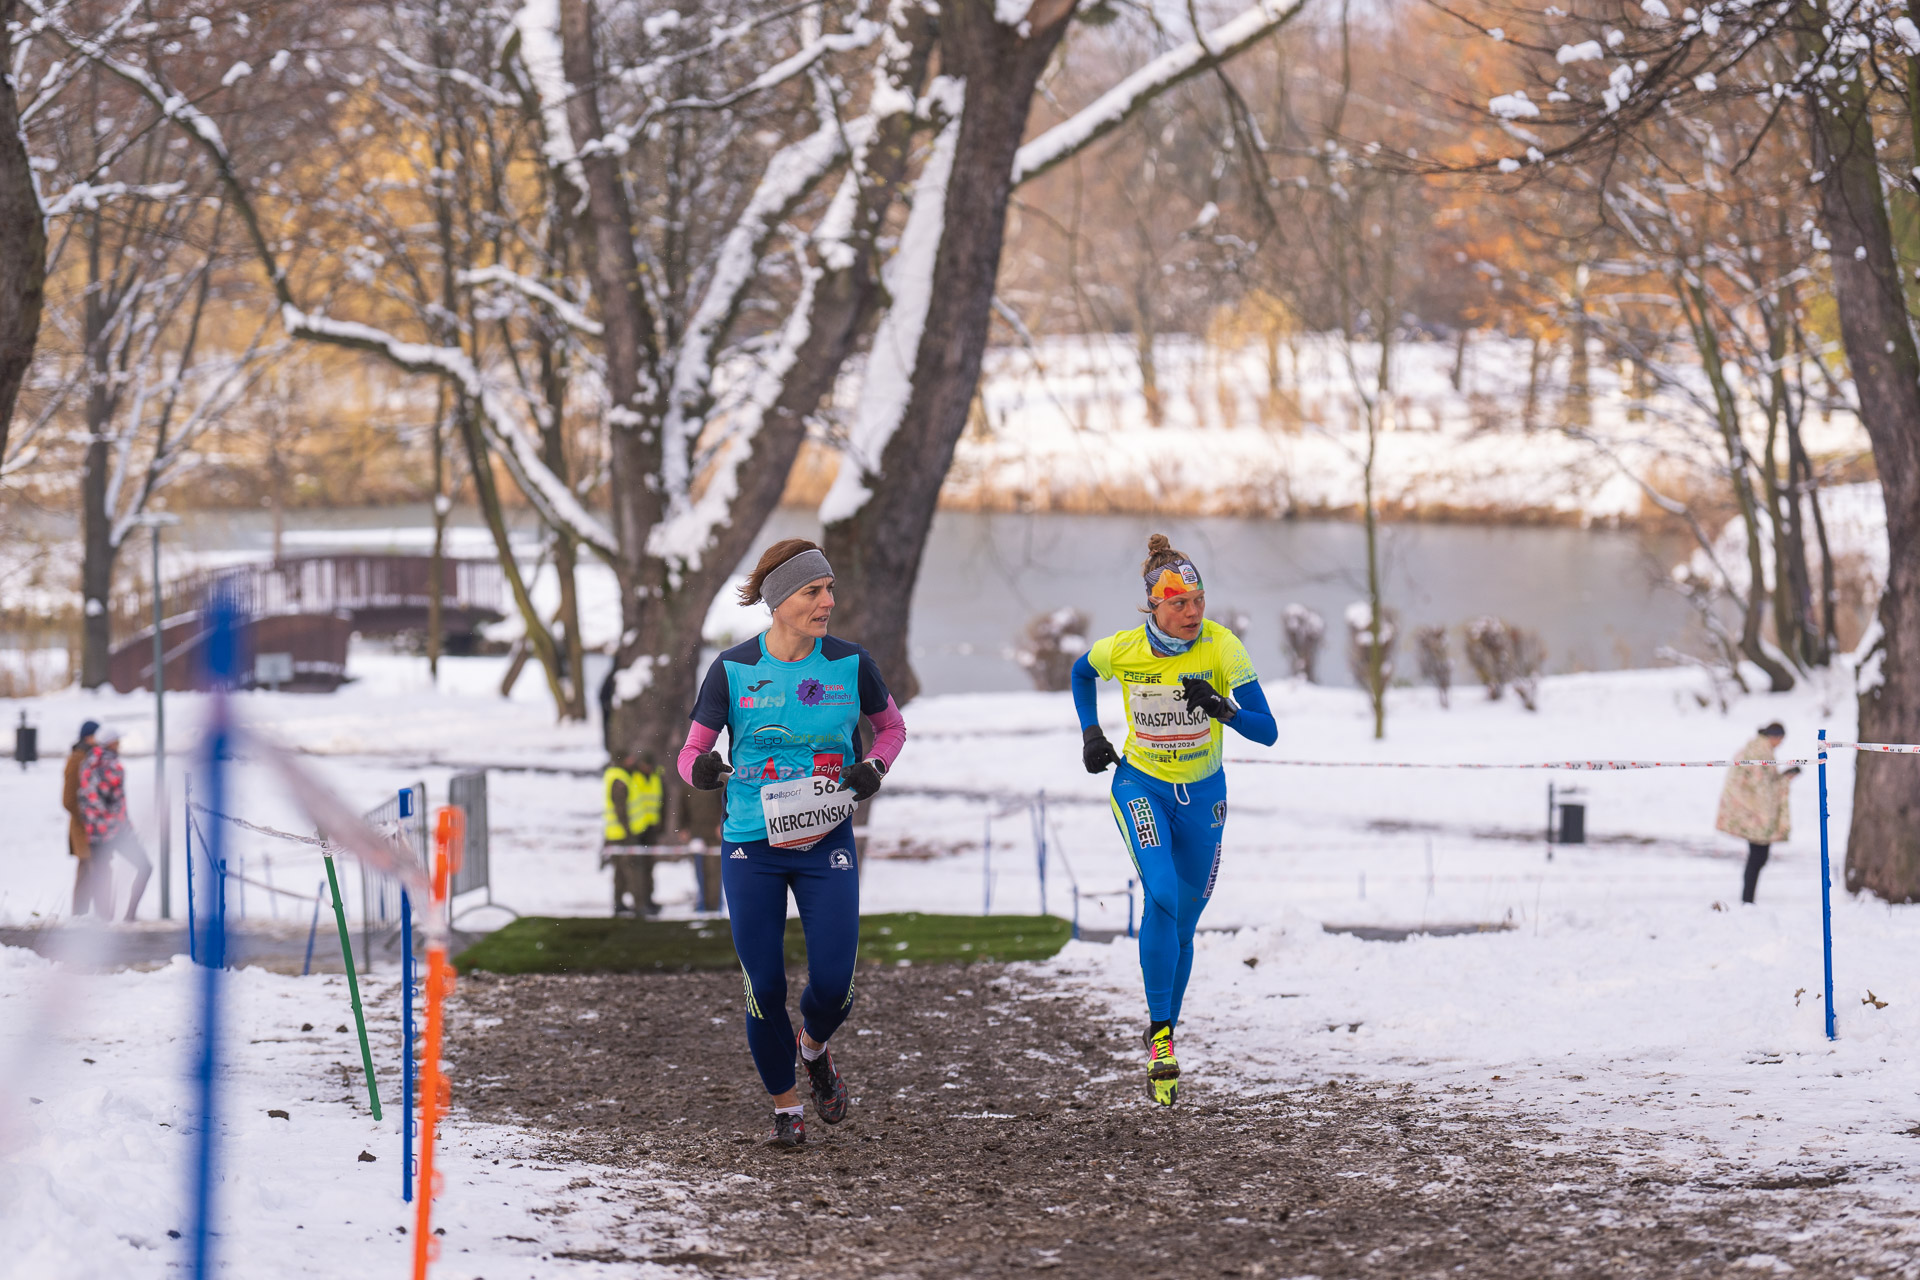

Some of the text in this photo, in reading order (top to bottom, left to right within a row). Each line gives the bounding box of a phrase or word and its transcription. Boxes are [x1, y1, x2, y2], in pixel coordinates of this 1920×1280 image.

[824, 684, 845, 692] EKIPA
[1133, 711, 1209, 728] KRASZPULSKA
[1151, 742, 1177, 750] BYTOM
[814, 762, 841, 775] ECHO
[769, 803, 855, 835] KIERCZYŃSKA
